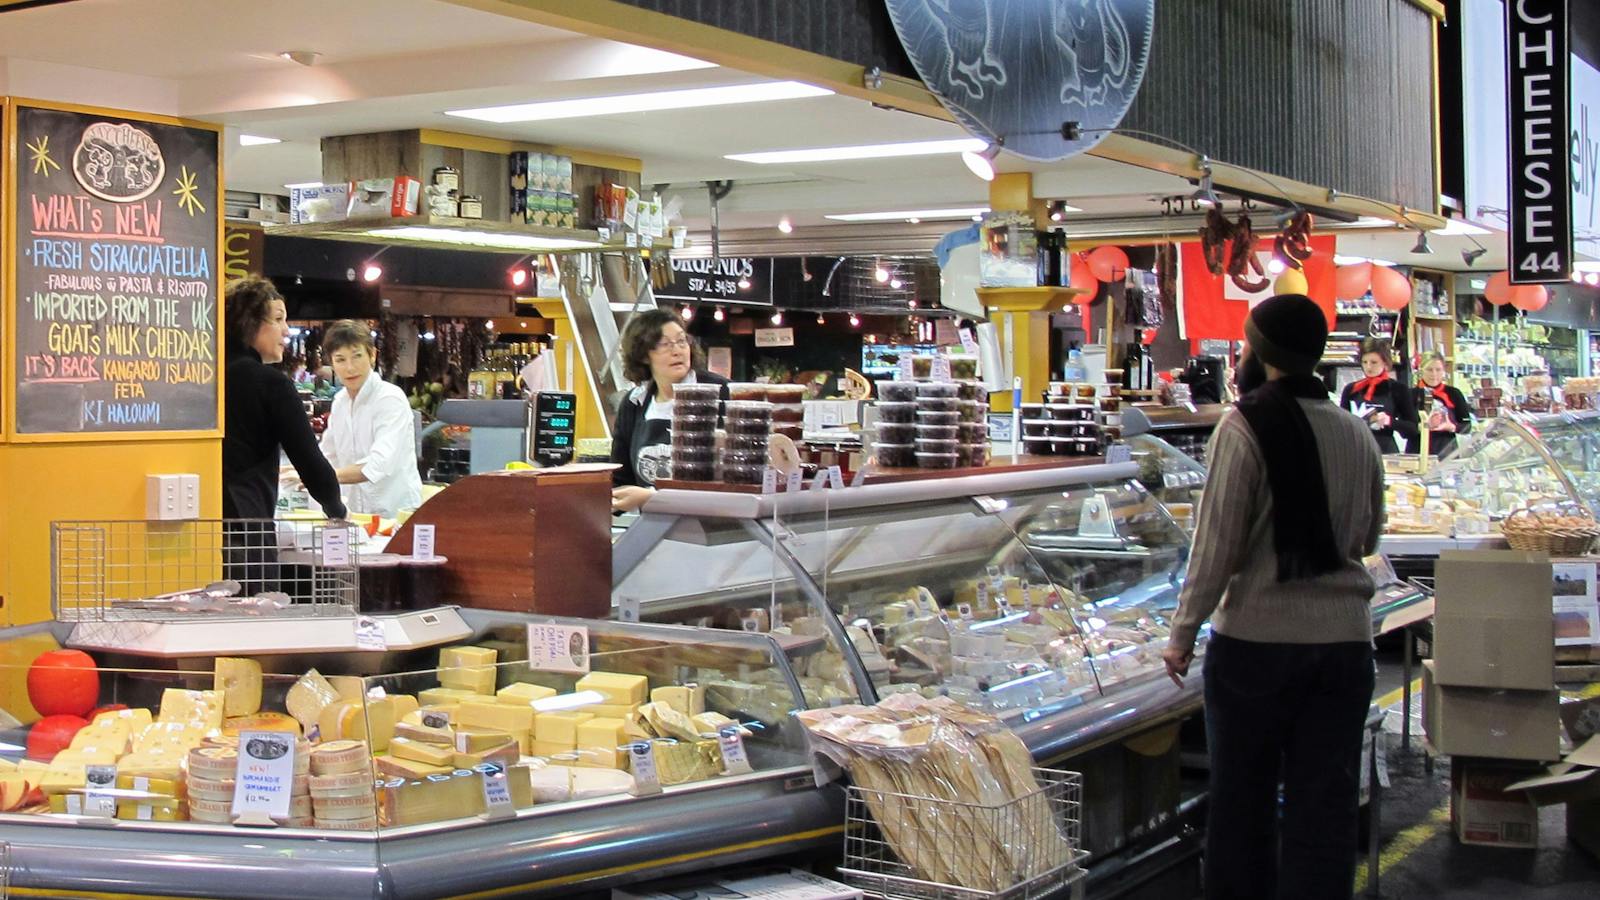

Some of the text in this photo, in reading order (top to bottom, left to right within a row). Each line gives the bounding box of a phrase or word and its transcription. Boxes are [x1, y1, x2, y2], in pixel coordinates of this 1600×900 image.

[1516, 0, 1554, 243] CHEESE
[115, 199, 162, 237] NEW
[33, 239, 210, 281] FRESH STRACCIATELLA
[670, 256, 754, 277] ORGANICS
[1519, 252, 1561, 274] 44
[119, 276, 151, 294] PASTA
[167, 281, 208, 298] RISOTTO
[34, 291, 213, 331] IMPORTED FROM THE UK
[105, 324, 141, 356] MILK
[145, 326, 213, 361] CHEDDAR
[61, 356, 99, 377] BACK
[103, 359, 161, 382] KANGAROO
[165, 361, 214, 386] ISLAND
[114, 379, 146, 400] FETA
[107, 402, 161, 424] HALOUMI
